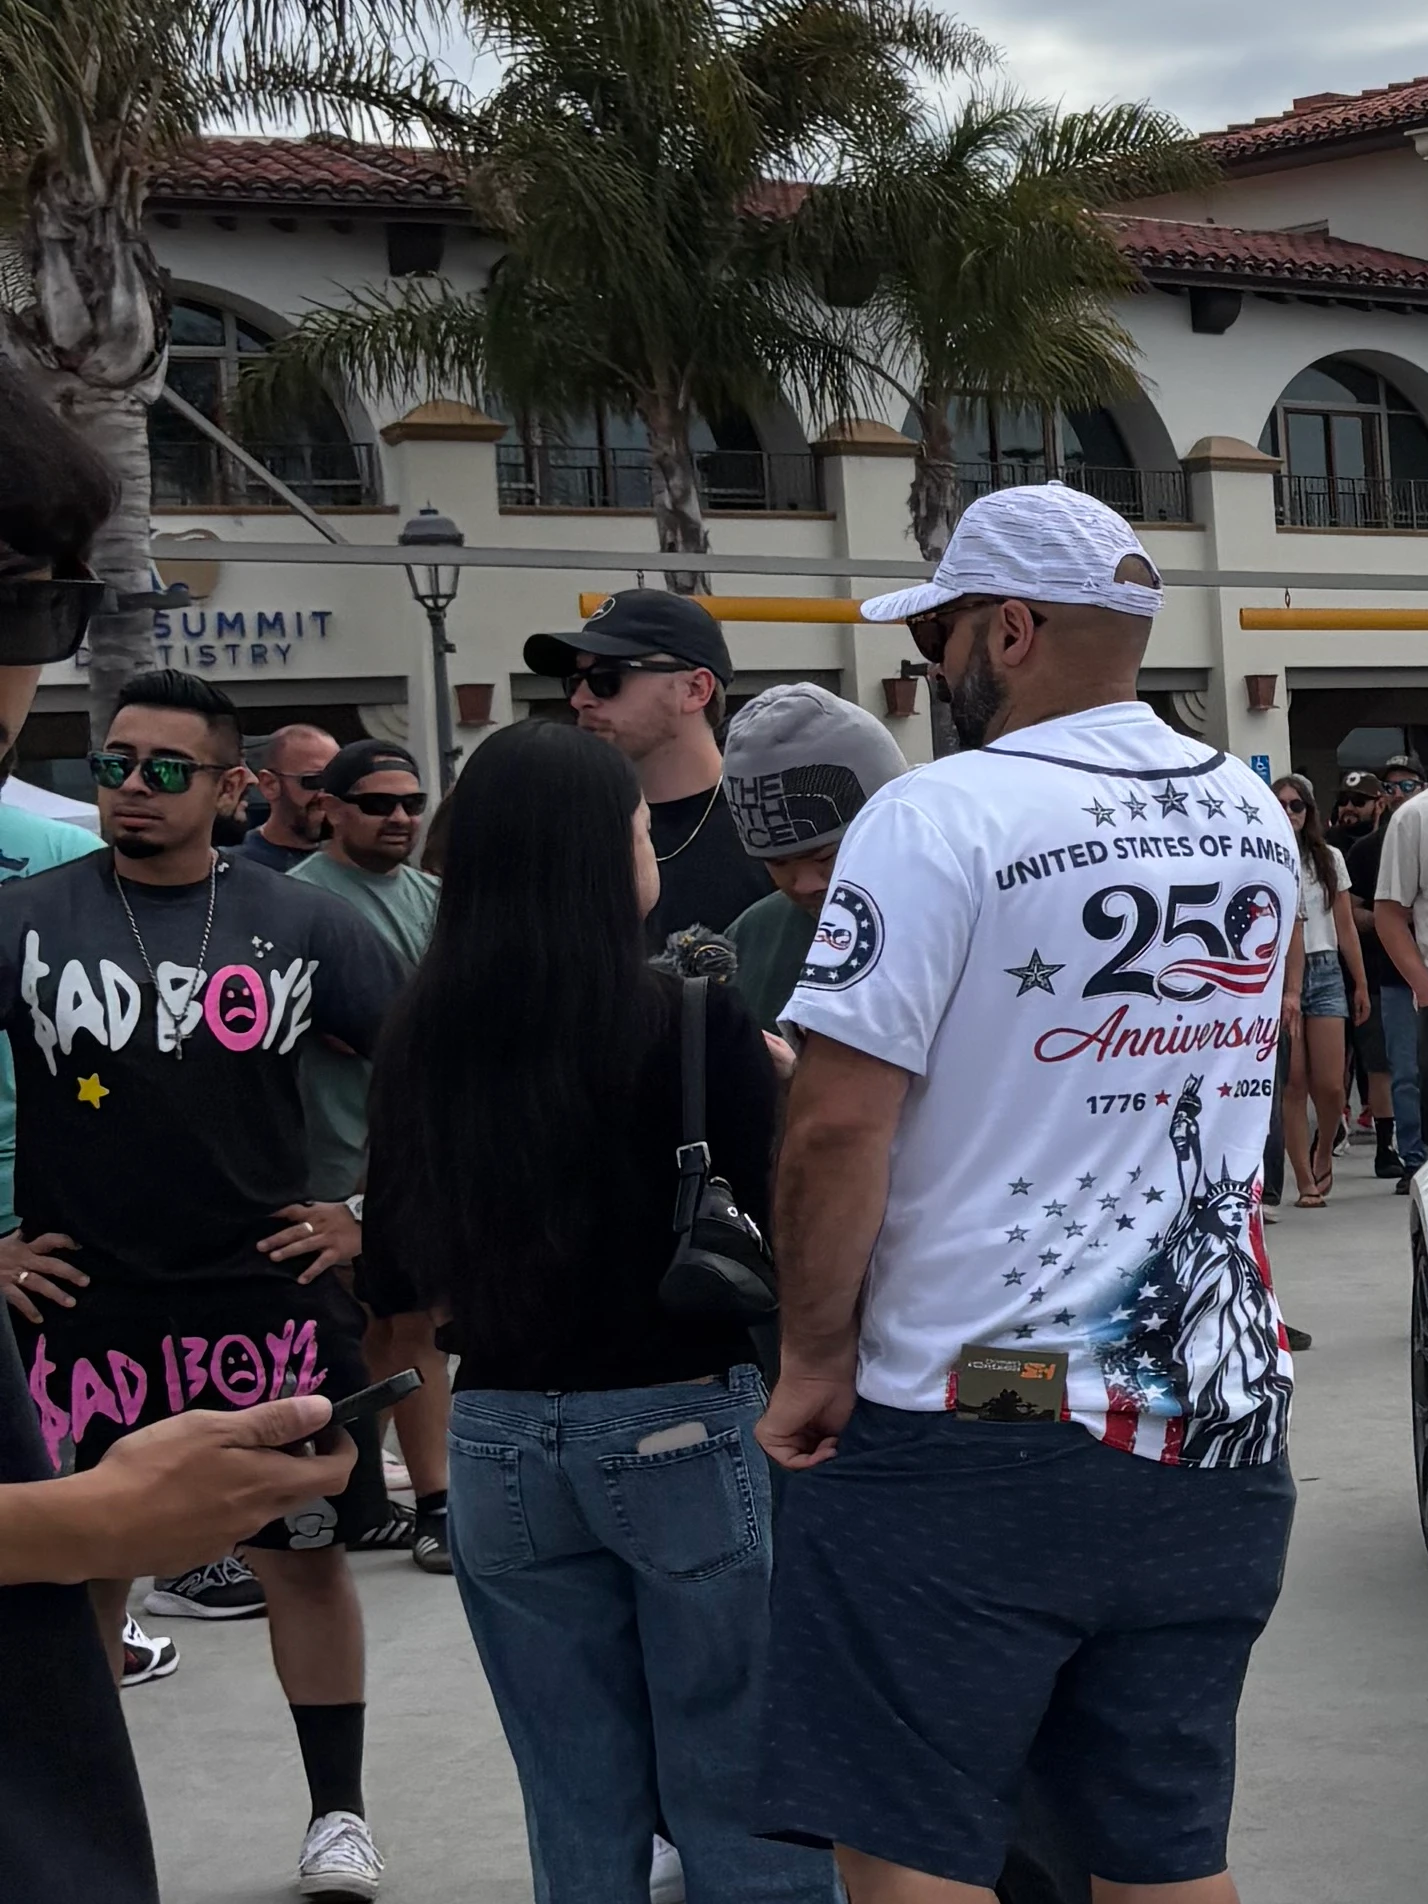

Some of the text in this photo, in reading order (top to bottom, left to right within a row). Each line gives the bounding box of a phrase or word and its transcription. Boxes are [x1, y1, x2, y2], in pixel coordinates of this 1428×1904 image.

[153, 610, 333, 639] SUMMIT
[75, 642, 292, 668] DTISTRY
[995, 840, 1108, 891] UNITED
[1113, 836, 1194, 859] STATES
[1199, 834, 1232, 857] OF
[1082, 881, 1282, 1004] 250
[1086, 1093, 1146, 1115] 1776
